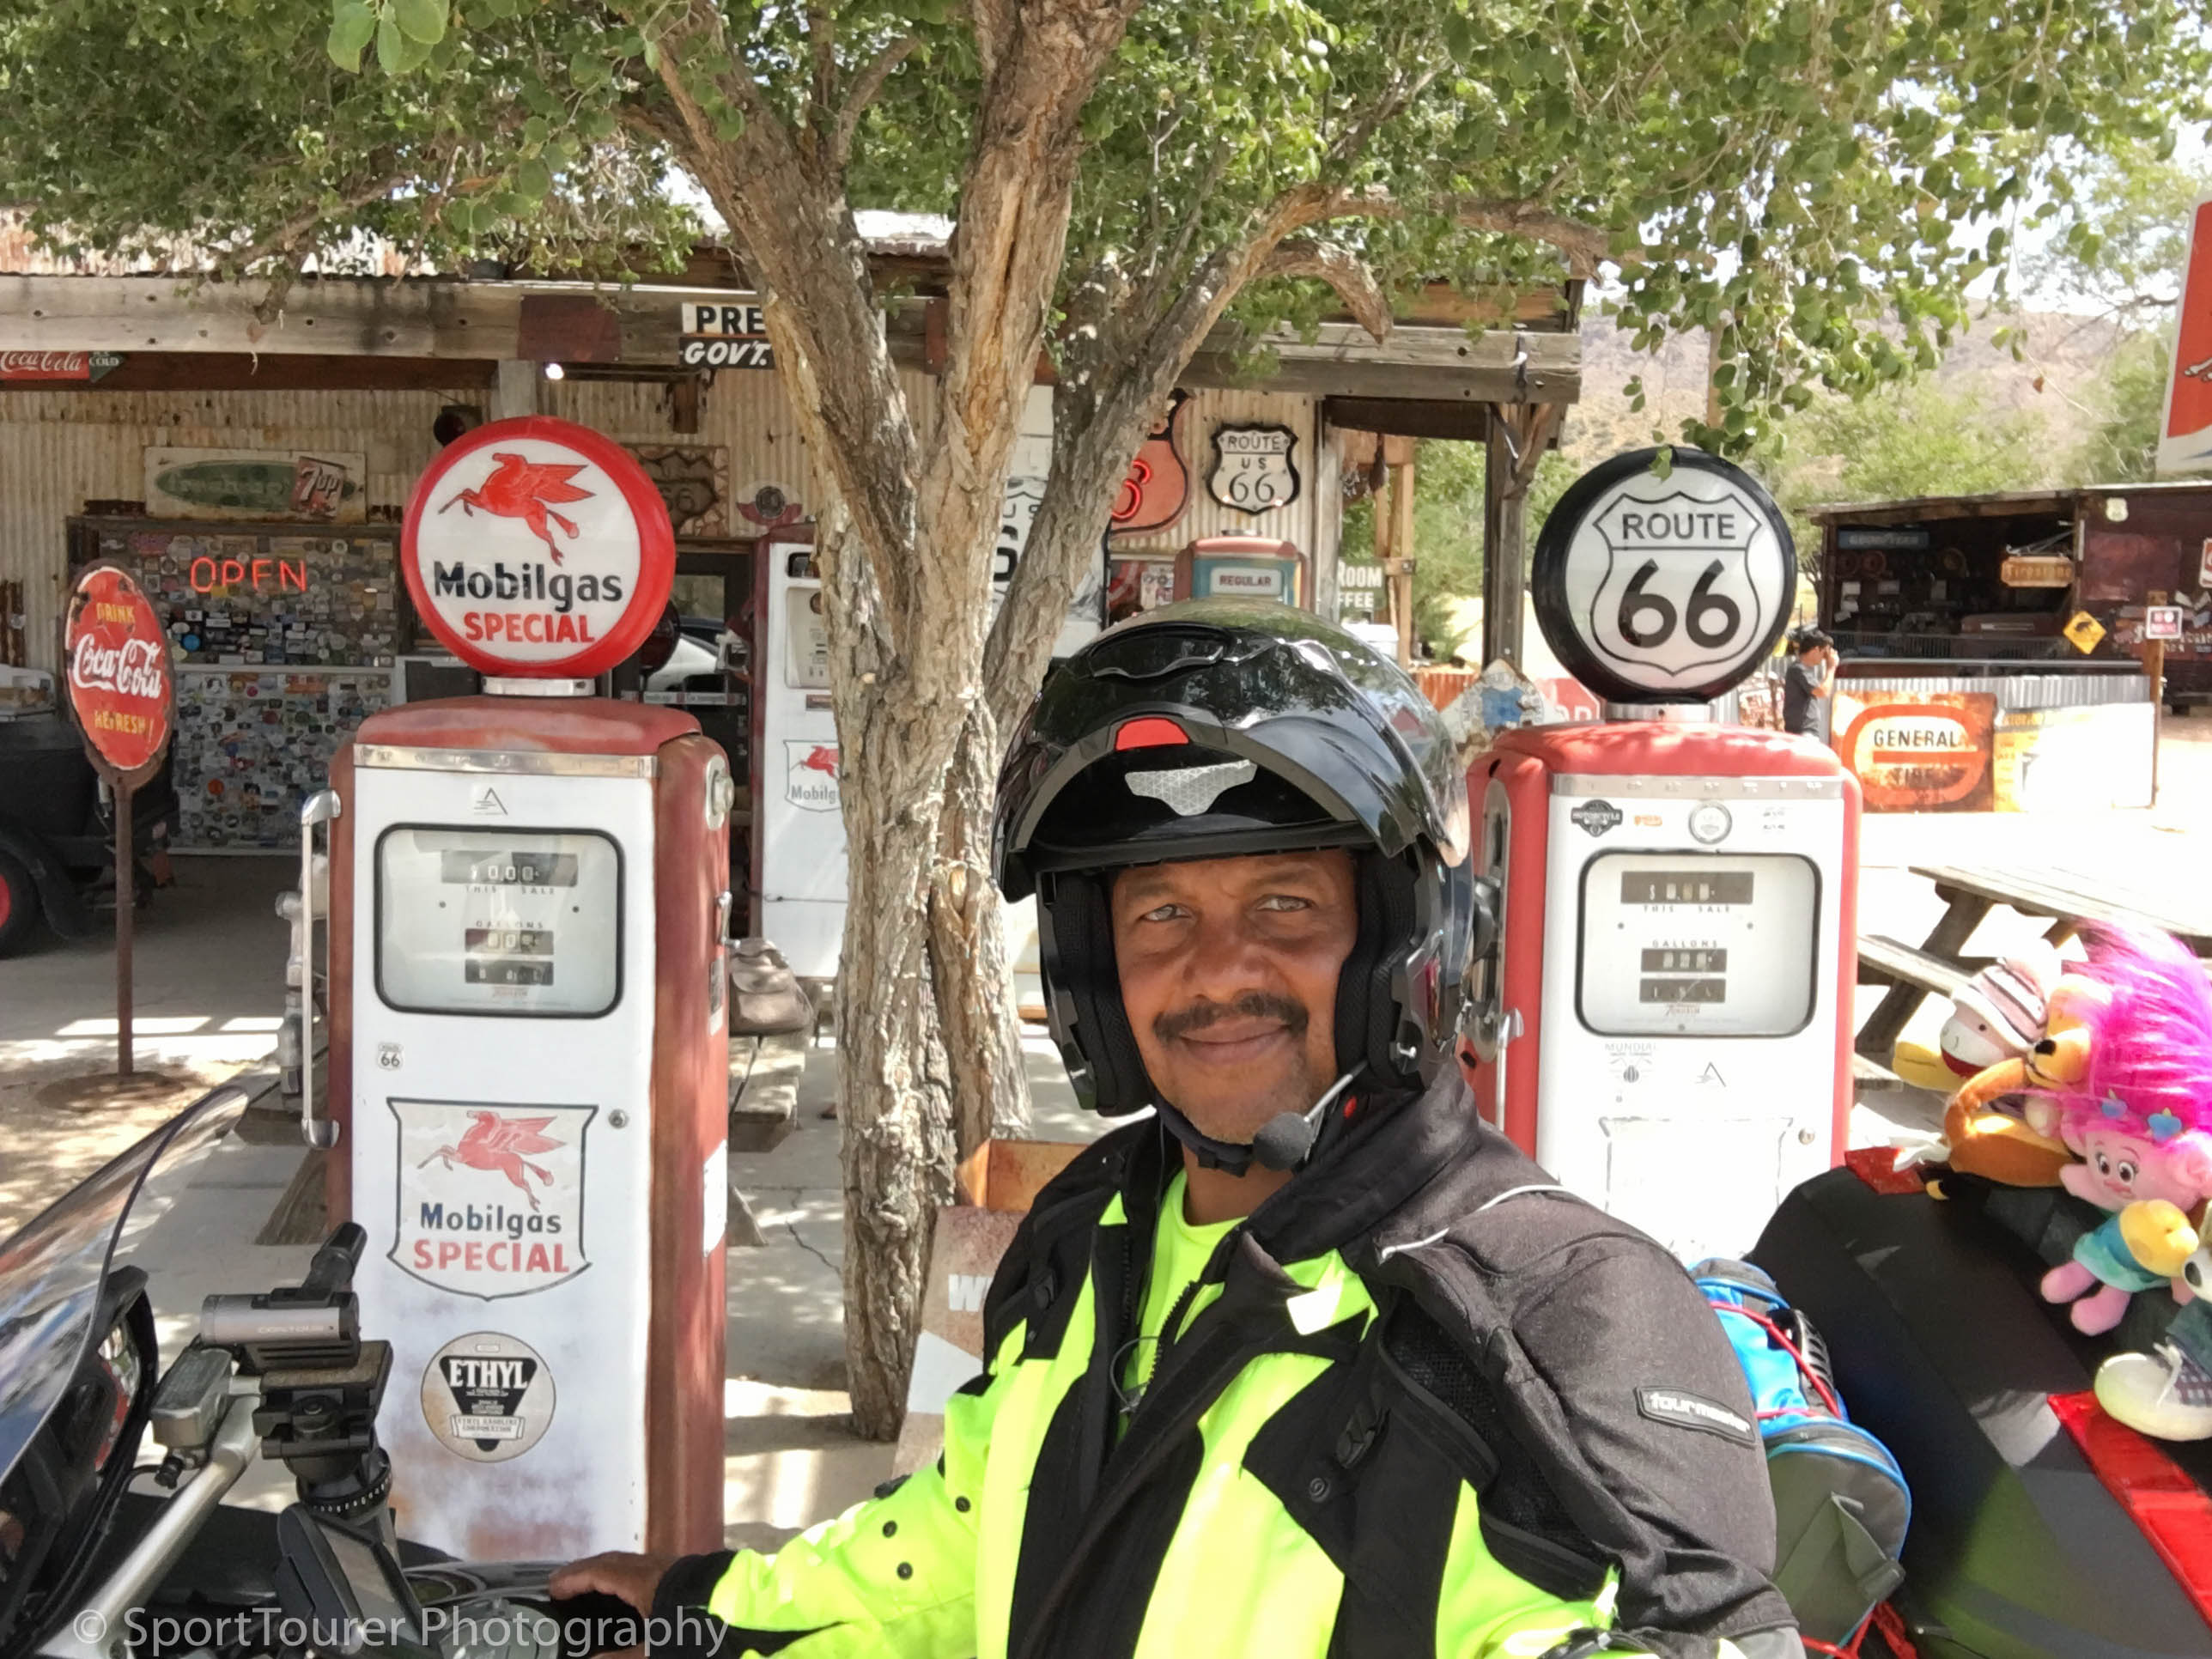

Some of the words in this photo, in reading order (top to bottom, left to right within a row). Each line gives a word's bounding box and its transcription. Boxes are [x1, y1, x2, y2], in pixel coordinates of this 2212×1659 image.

[684, 341, 772, 366] GOV'T.
[1228, 435, 1282, 451] ROUTE
[1229, 472, 1275, 503] 66
[1621, 513, 1736, 541] ROUTE
[190, 556, 307, 593] OPEN
[433, 561, 623, 613] Mobilgas
[1219, 574, 1273, 587] REGULAR
[95, 602, 137, 625] DRINK
[1338, 592, 1374, 609] FFEE
[1617, 558, 1741, 649] 66
[463, 611, 596, 644] SPECIAL
[1873, 729, 1958, 748] GENERAL
[790, 784, 839, 804] Mobilg
[380, 1052, 401, 1067] 66
[420, 1202, 562, 1240] Mobilgas
[413, 1239, 570, 1274] SPECIAL
[448, 1358, 529, 1389] ETHYL
